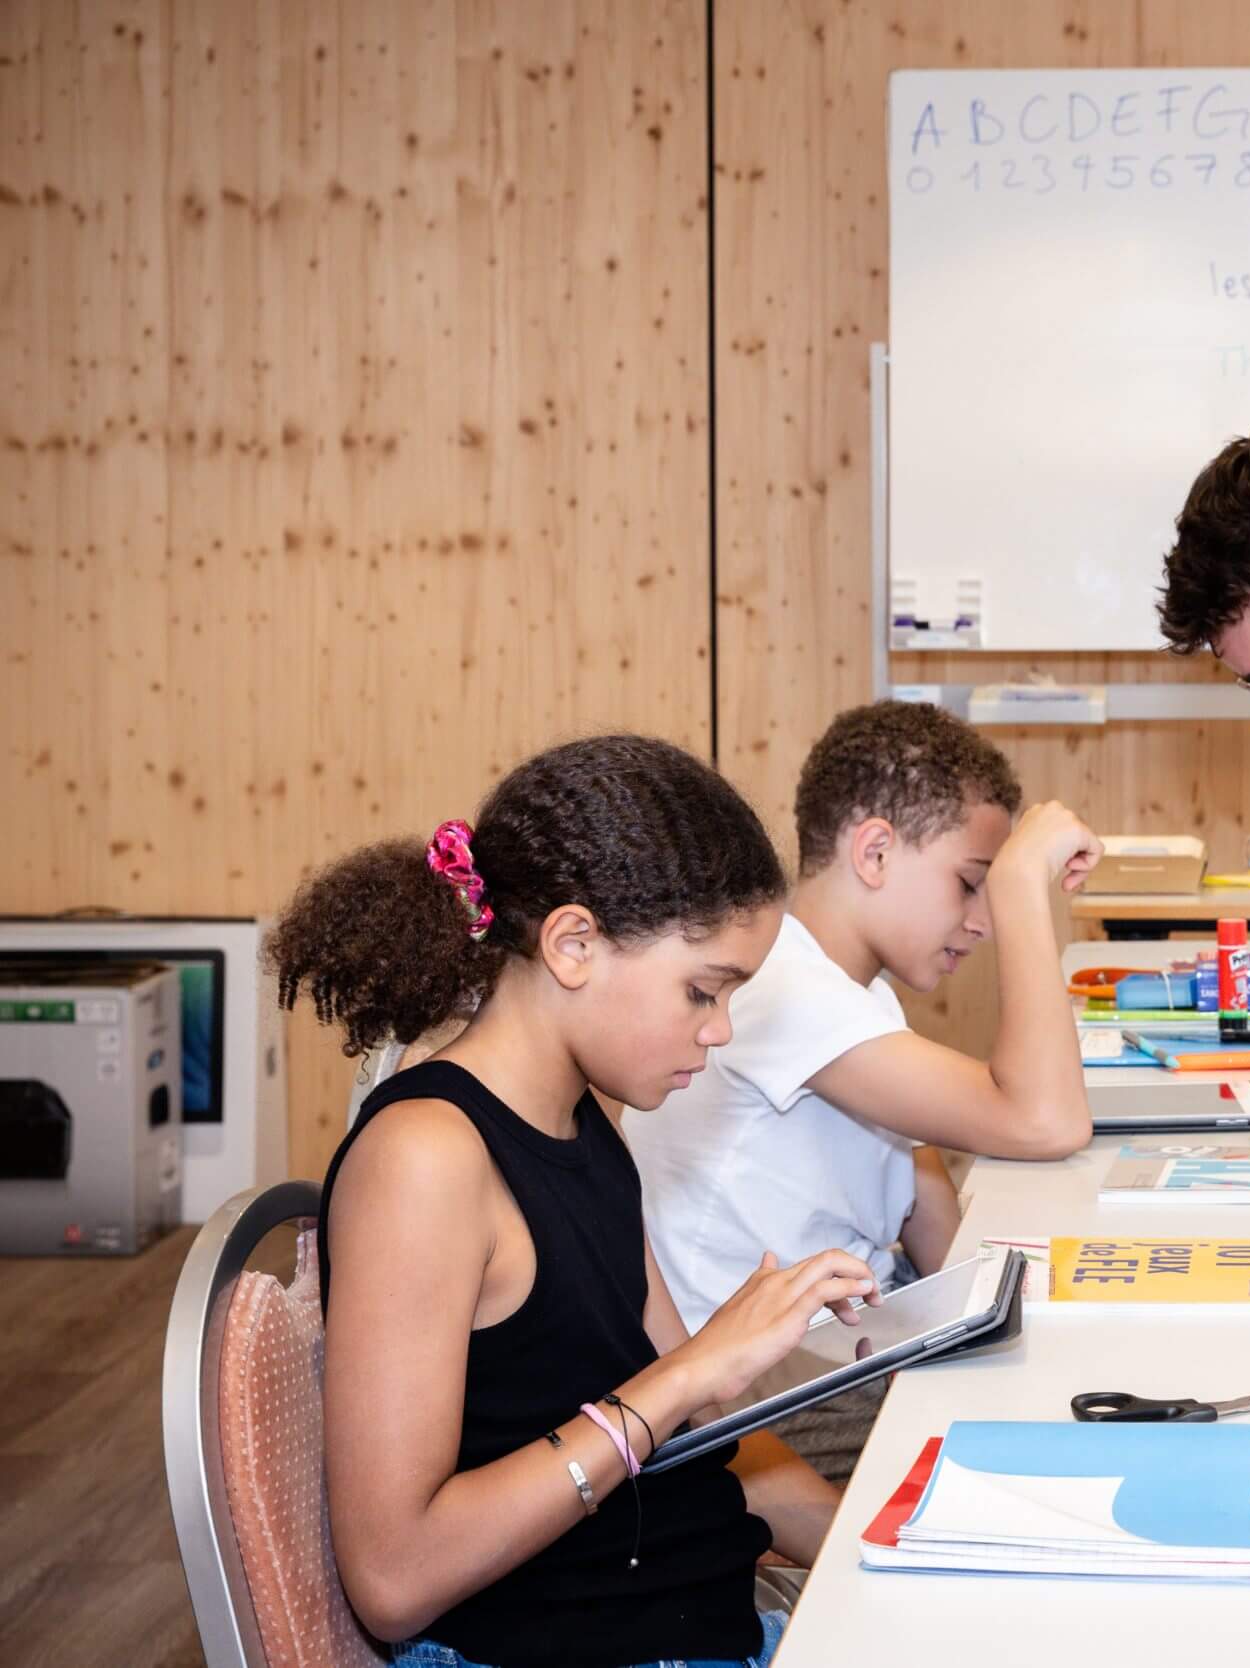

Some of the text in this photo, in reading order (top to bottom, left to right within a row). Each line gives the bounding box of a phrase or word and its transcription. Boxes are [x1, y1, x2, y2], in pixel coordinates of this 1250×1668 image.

[911, 101, 946, 155] A
[970, 98, 1005, 147] B
[1019, 94, 1058, 143] C
[1068, 92, 1101, 142] D
[1110, 93, 1142, 136] E
[1157, 85, 1191, 131] F
[1192, 84, 1250, 139] G
[907, 166, 933, 192] 0
[961, 161, 980, 190] 1
[1002, 160, 1023, 188] 2
[1033, 155, 1055, 193] 3
[1072, 156, 1094, 191] 4
[1107, 156, 1138, 189] 5
[1149, 154, 1174, 187] 6
[1185, 154, 1217, 184] 7
[1072, 1242, 1139, 1283] de FLE
[1132, 1242, 1211, 1274] jeux
